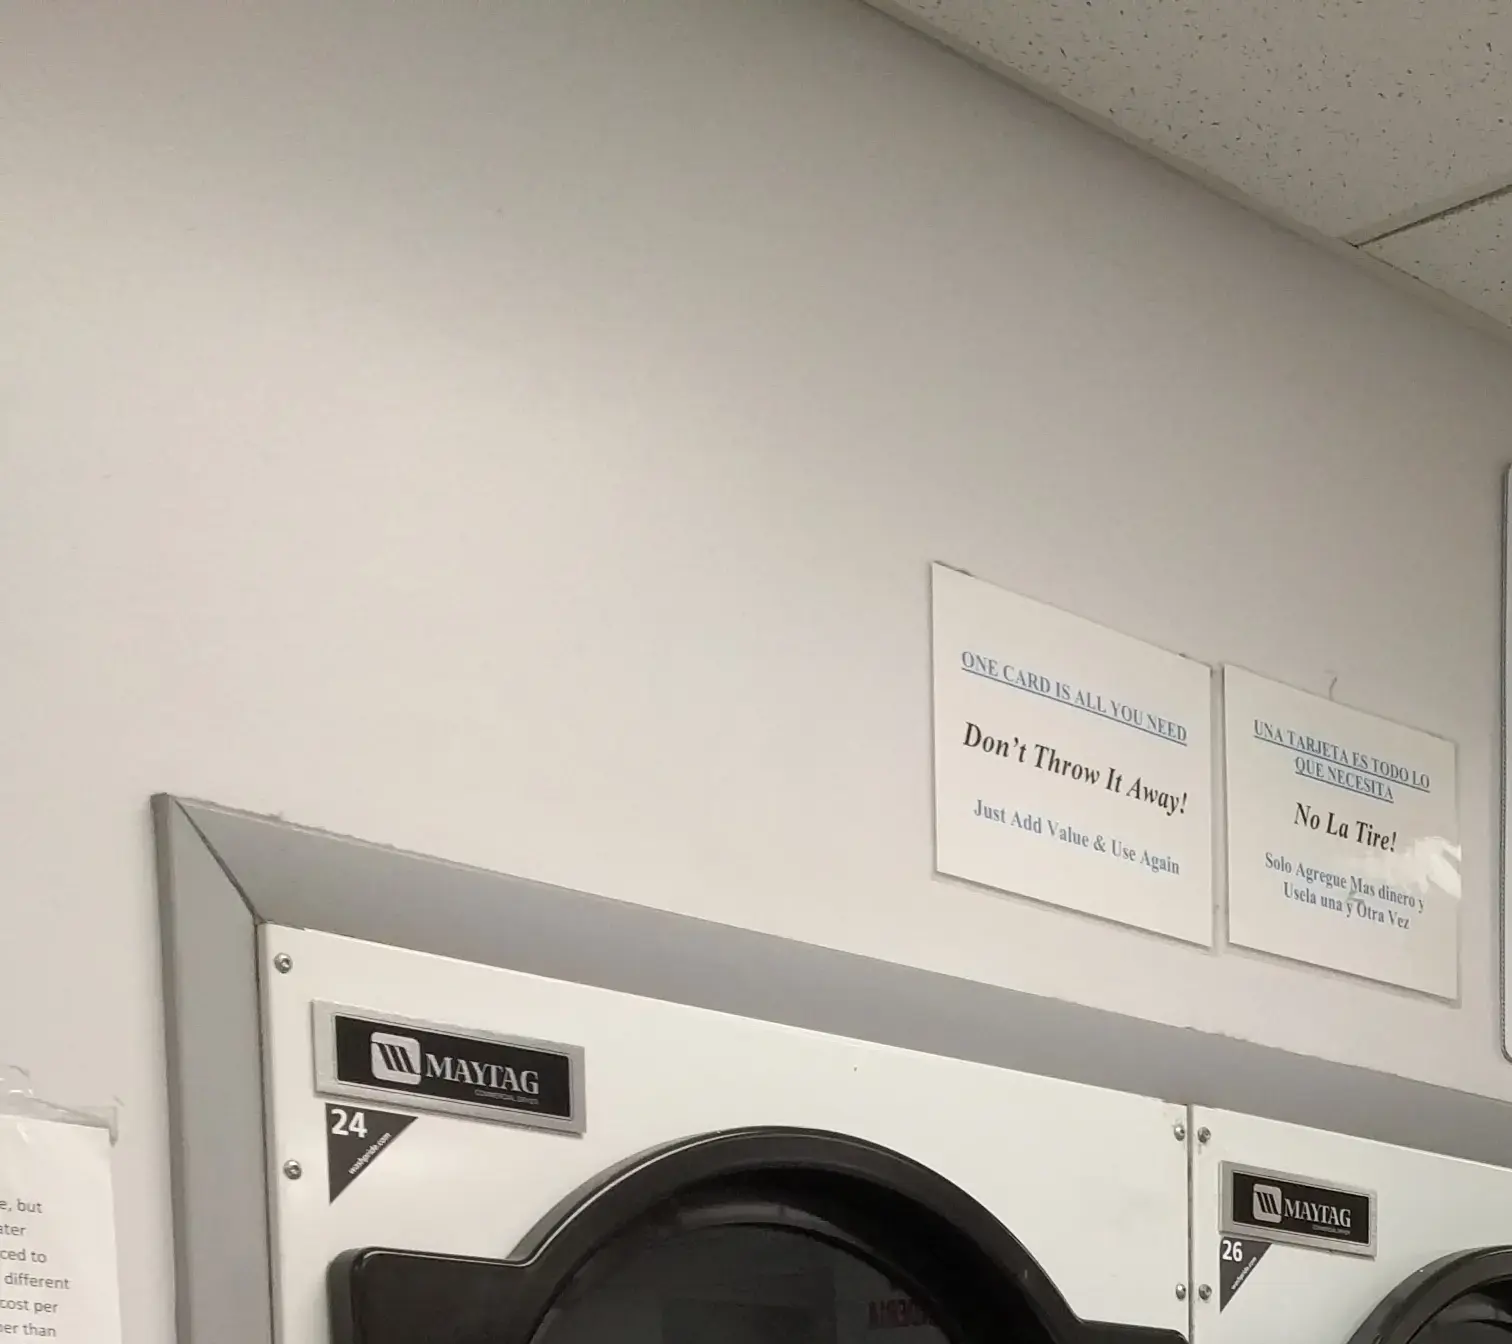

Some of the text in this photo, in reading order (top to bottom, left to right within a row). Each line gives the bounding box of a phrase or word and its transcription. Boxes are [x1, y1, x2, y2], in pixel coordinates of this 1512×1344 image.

[961, 651, 1188, 742] ONE CARD IS ALL YOU NEED
[963, 722, 1188, 816] Don't Throw It Away!
[1254, 719, 1430, 788] UNA TARJETA ES TODO LO
[1295, 756, 1393, 800] QUE NECESITA
[973, 799, 1180, 875] Just Add Value & Use Again
[1294, 802, 1397, 852] No La Tire!
[1265, 851, 1425, 914] Solo Agregue Mas dinero y
[1283, 881, 1410, 930] Usela una y Otra Vez
[426, 1053, 539, 1095] MAYTAG
[331, 1108, 368, 1138] 24
[17, 1198, 43, 1214] but
[1284, 1198, 1351, 1228] MAYTAG
[31, 1252, 48, 1263] to
[1222, 1240, 1243, 1262] 26
[4, 1272, 71, 1289] different
[34, 1302, 58, 1314] per
[22, 1322, 57, 1337] than
